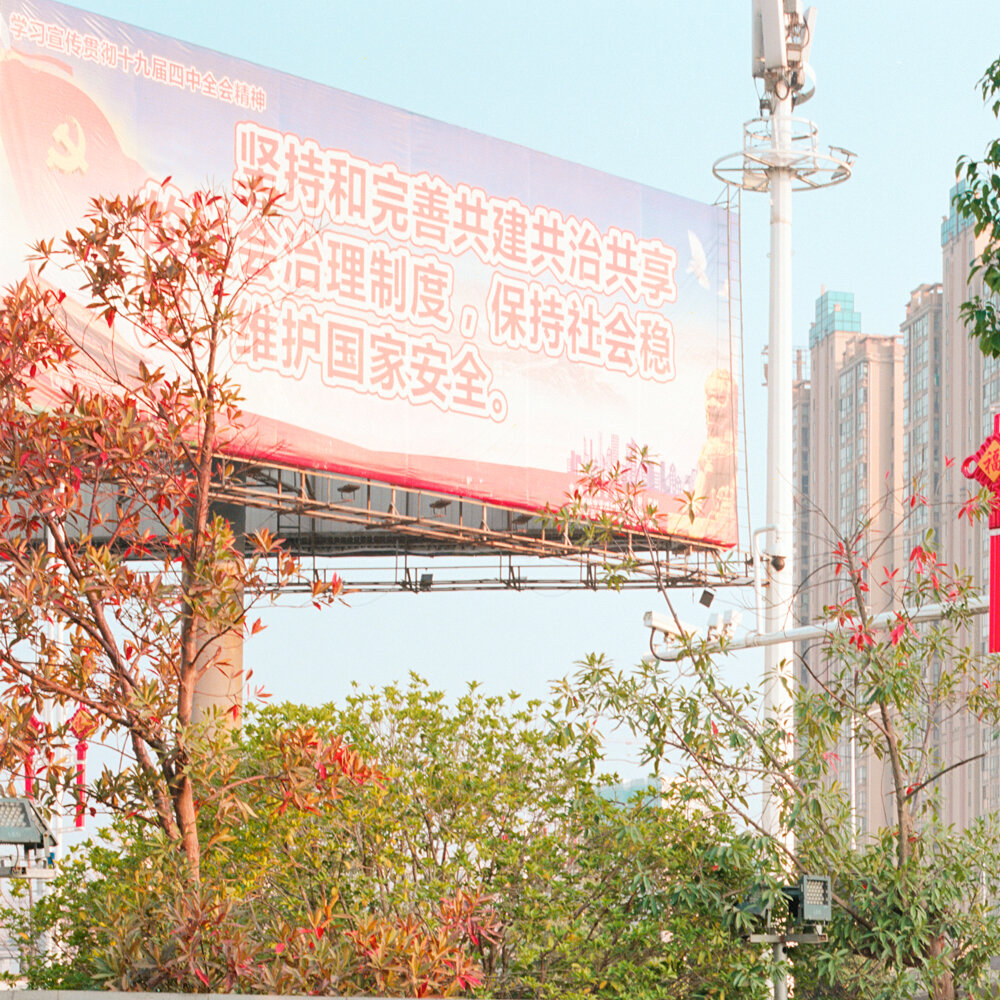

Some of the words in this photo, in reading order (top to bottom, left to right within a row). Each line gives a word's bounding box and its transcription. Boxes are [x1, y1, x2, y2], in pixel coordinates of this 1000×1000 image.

[10, 14, 266, 111] 学习宣传贯彻十九届四中全会精神
[146, 187, 672, 376] 会治理制度，保持社会稳
[240, 130, 673, 302] 坚持和完善共建共治共享
